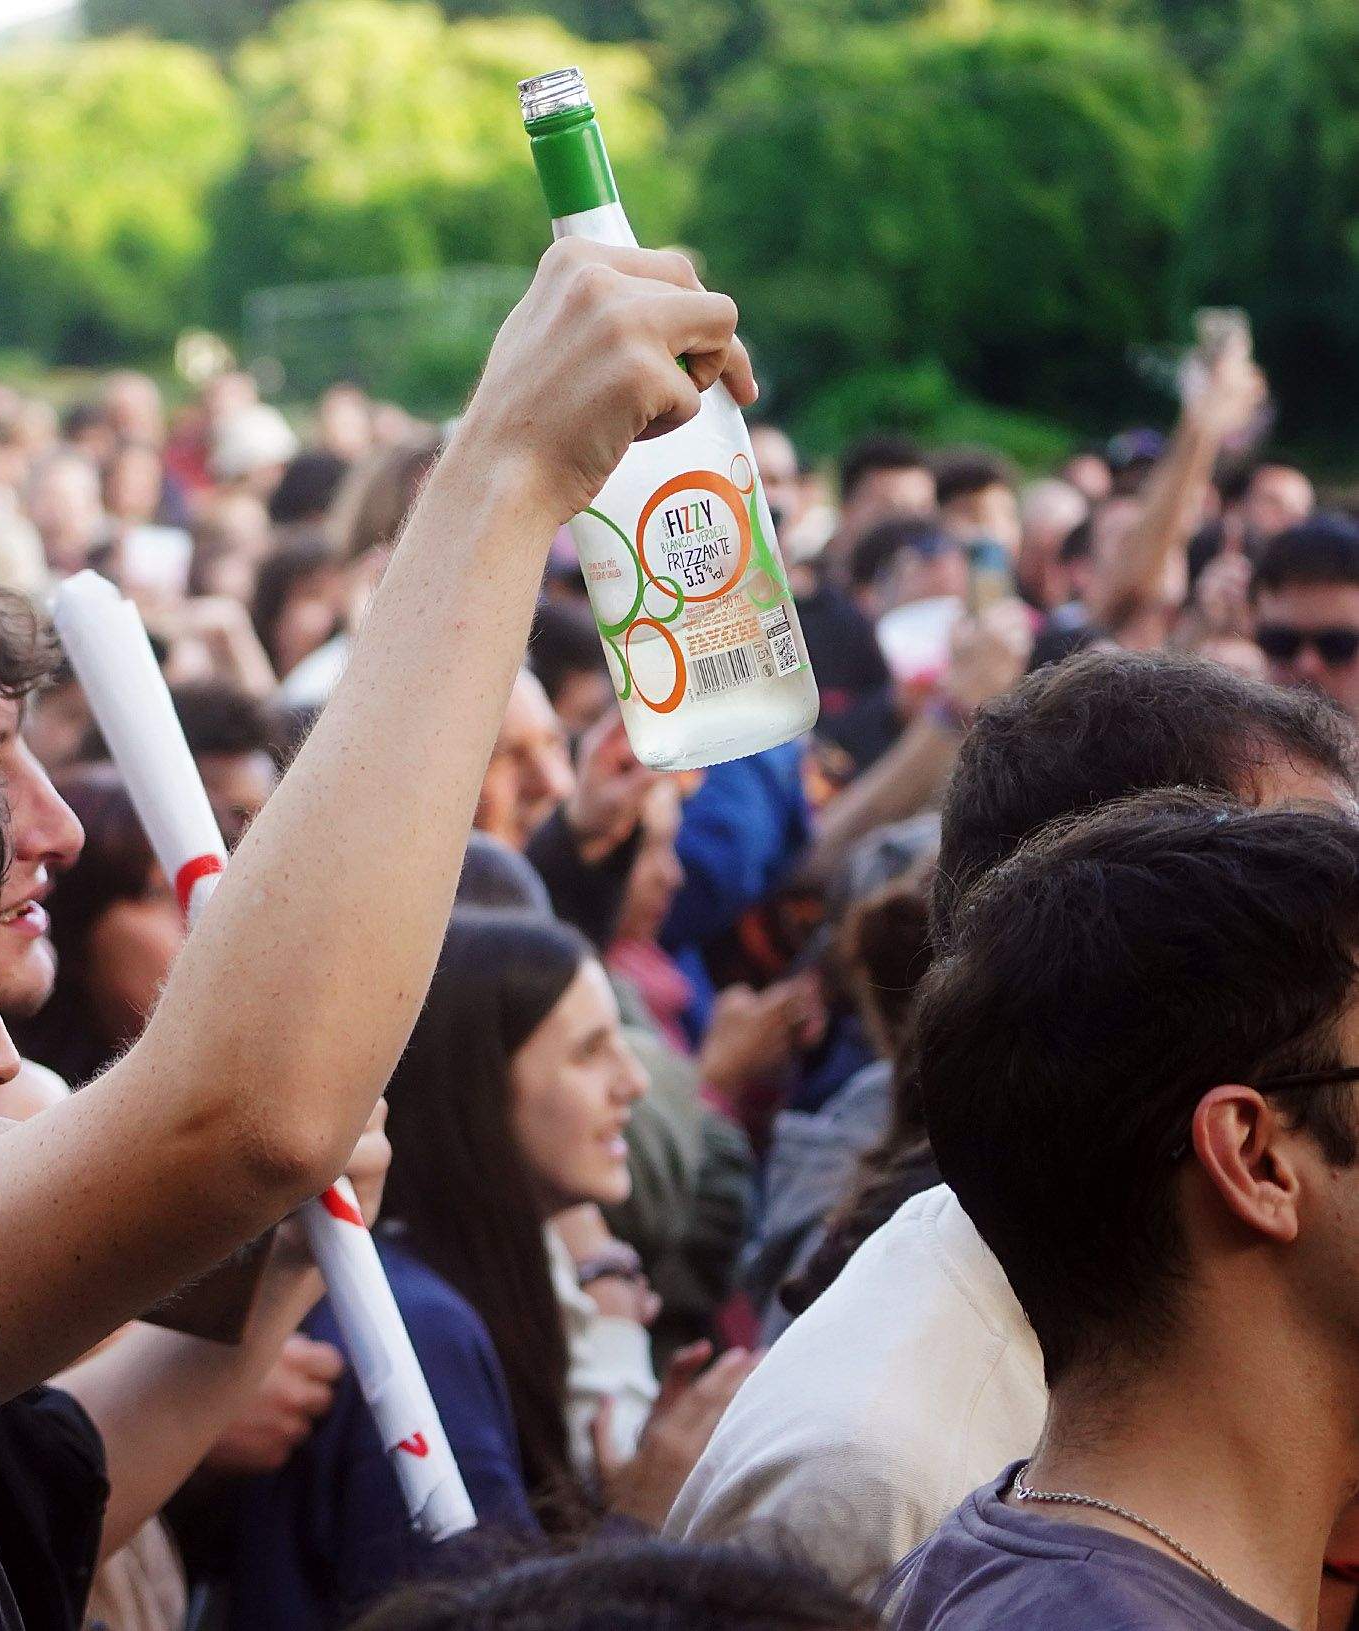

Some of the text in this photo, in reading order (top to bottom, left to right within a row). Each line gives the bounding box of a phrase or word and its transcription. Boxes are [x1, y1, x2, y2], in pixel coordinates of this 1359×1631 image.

[665, 499, 712, 537] FIZZY
[661, 524, 728, 553] BLANCO VERDEJO
[667, 537, 732, 571] FRIZZANTE
